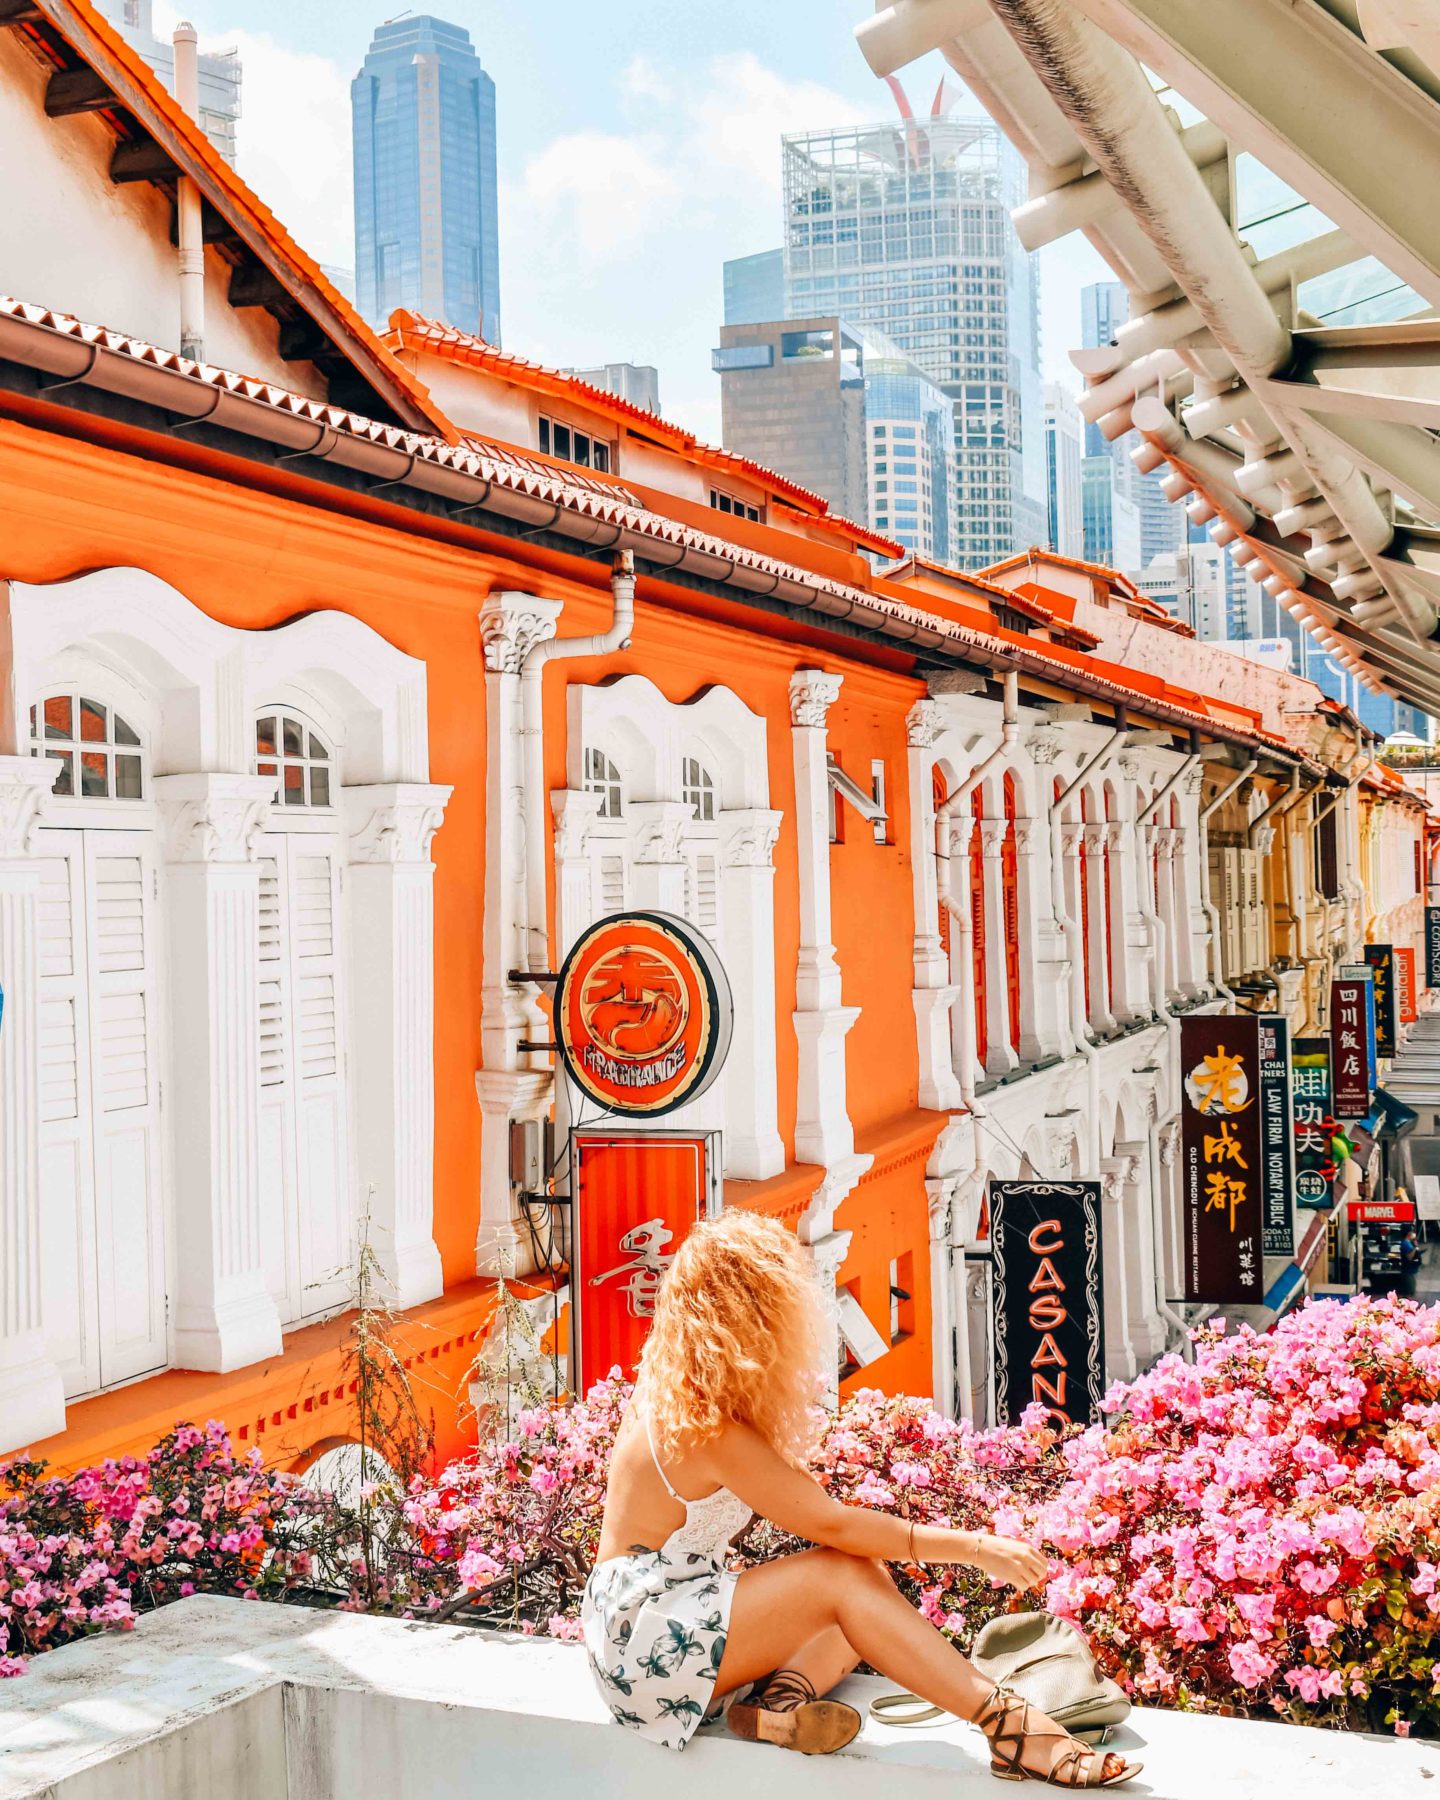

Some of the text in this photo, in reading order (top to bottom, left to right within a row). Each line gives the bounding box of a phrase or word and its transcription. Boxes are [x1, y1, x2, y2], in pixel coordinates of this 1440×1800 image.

[1339, 989, 1361, 1076] 四川飯店
[583, 1041, 687, 1088] FRAGRANCE
[1267, 1088, 1282, 1114] LAW
[1193, 1045, 1255, 1234] 老成都
[1268, 1117, 1283, 1145] FIRM
[1189, 1146, 1197, 1163] OLD
[1268, 1152, 1284, 1191] NOTARY
[1190, 1164, 1198, 1205] CHENGDU
[1269, 1193, 1285, 1226] PUBLIC
[1364, 1206, 1395, 1218] MARVEL
